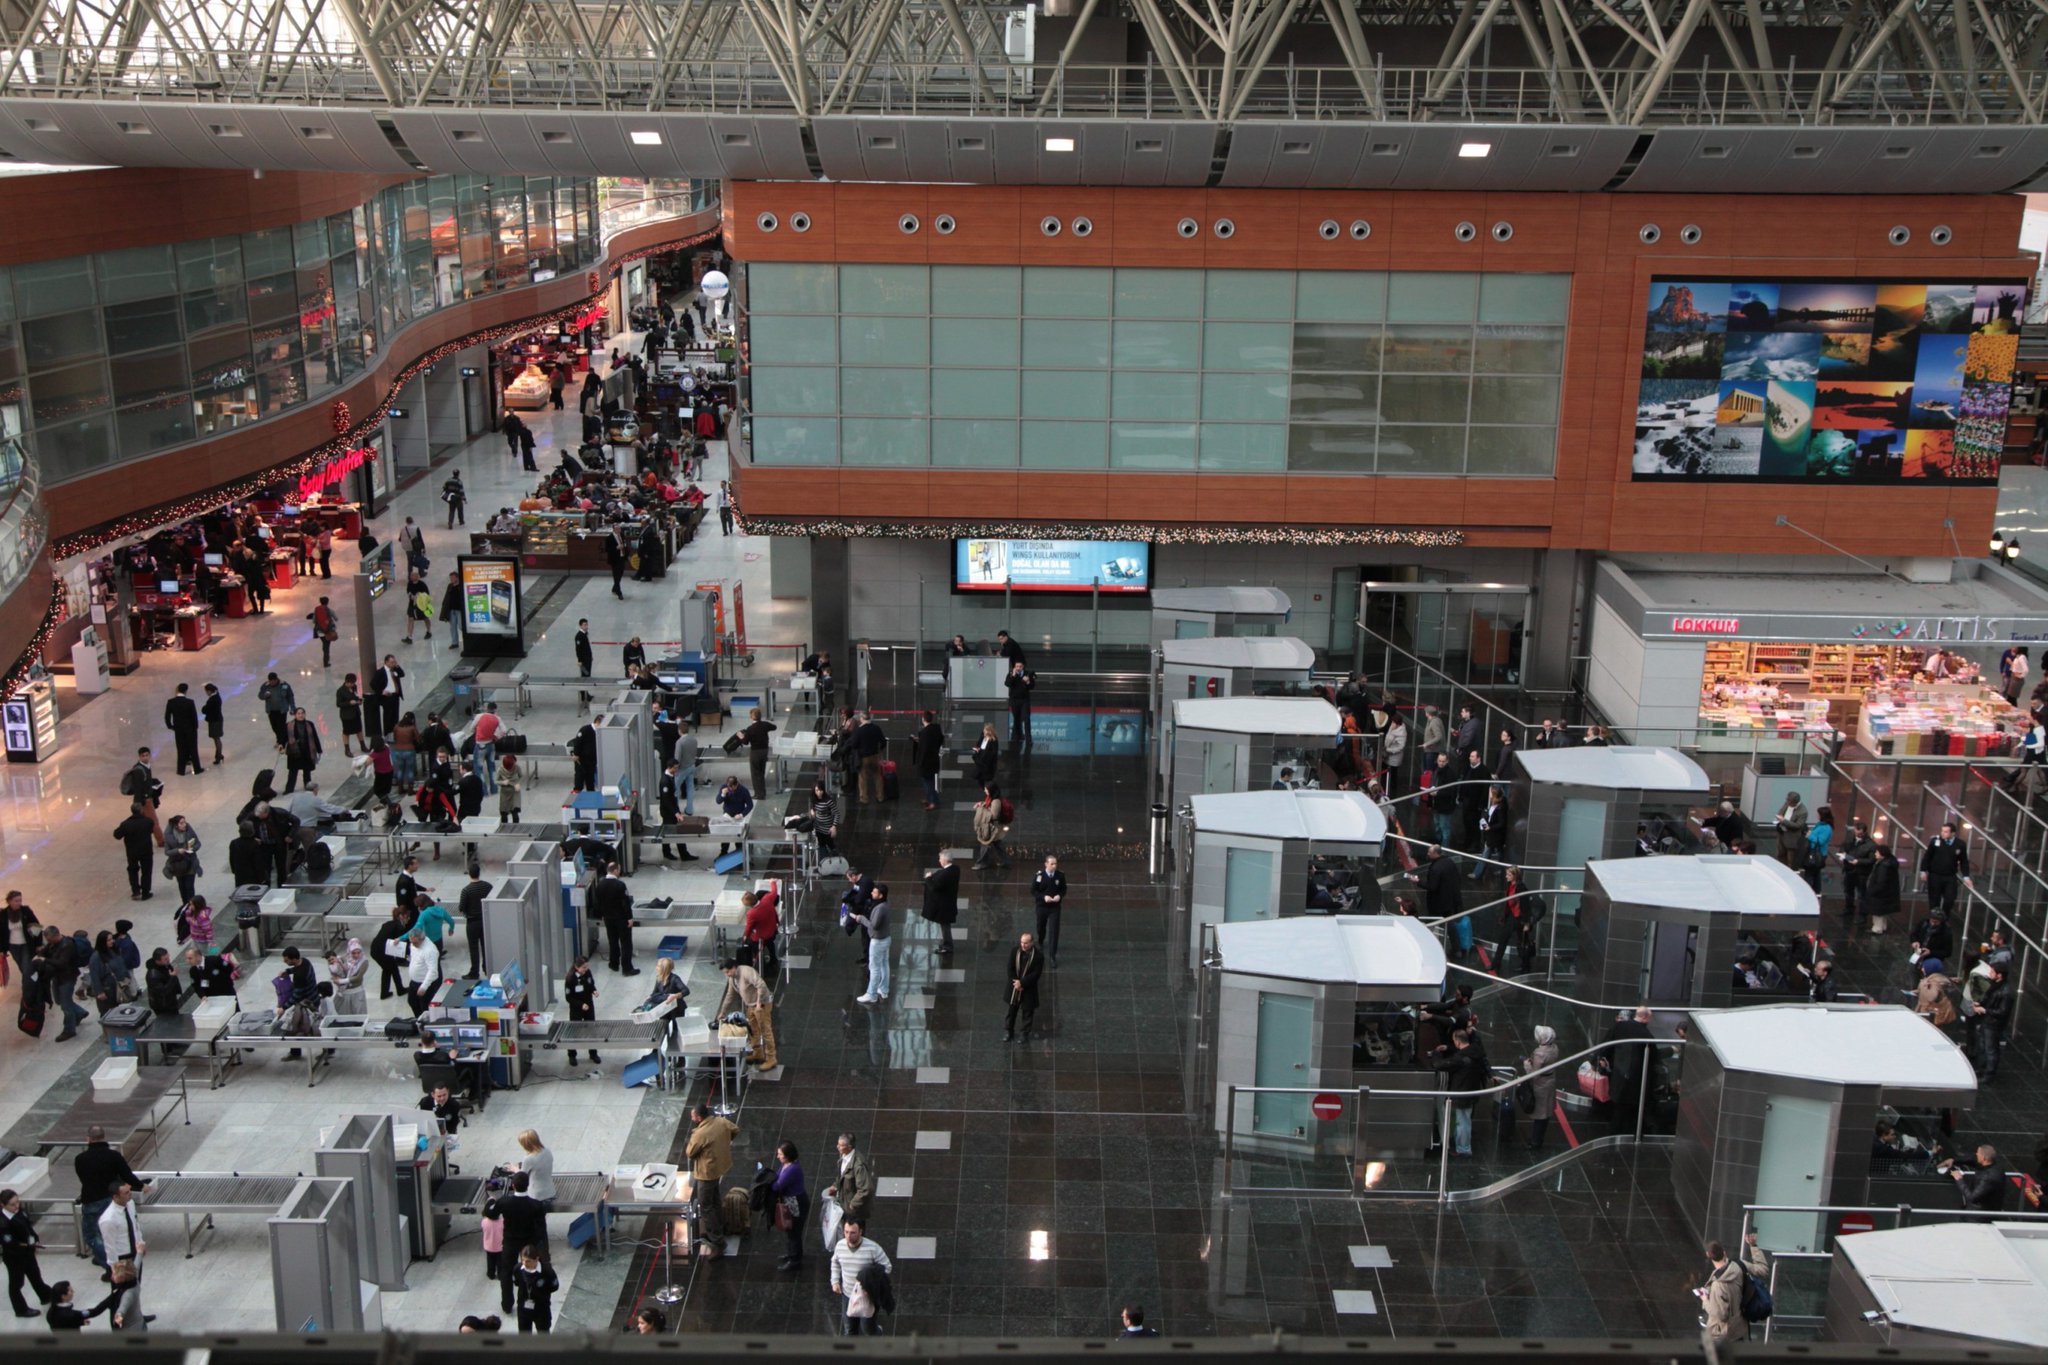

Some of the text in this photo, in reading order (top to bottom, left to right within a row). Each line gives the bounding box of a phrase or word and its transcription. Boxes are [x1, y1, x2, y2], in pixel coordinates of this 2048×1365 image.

[299, 474, 325, 501] Setur
[1012, 541, 1054, 551] YURT DIŞINDA
[1012, 551, 1033, 559] WINGS
[1673, 617, 1739, 634] LOKKUM
